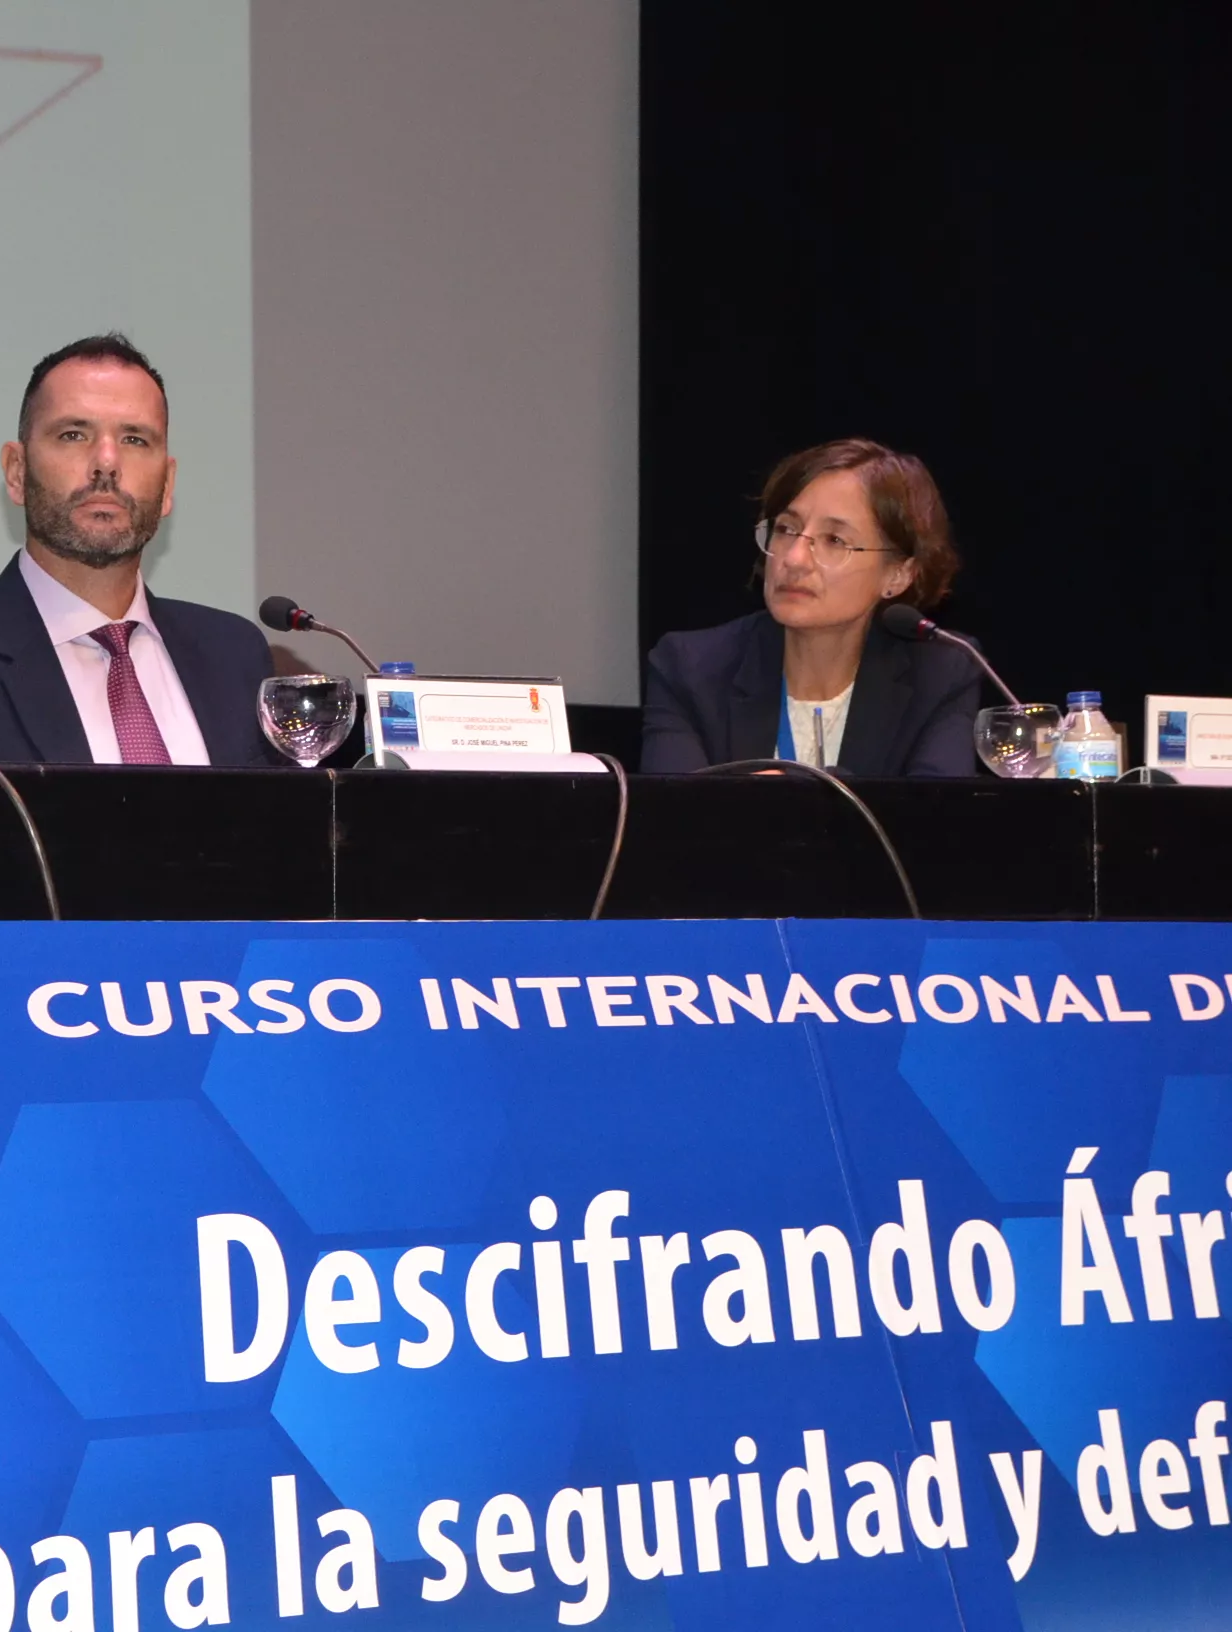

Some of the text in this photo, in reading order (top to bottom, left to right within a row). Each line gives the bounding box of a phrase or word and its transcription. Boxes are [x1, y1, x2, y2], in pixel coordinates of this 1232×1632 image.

[467, 738, 479, 746] JOSÉ
[26, 978, 382, 1039] CURSO
[419, 973, 1151, 1030] INTERNACIONAL
[1168, 973, 1232, 1022] D
[196, 1146, 1232, 1384] Descifrando Áfr
[271, 1474, 380, 1618] la
[417, 1420, 968, 1626] seguridad
[988, 1449, 1043, 1582] y
[1076, 1400, 1230, 1537] def
